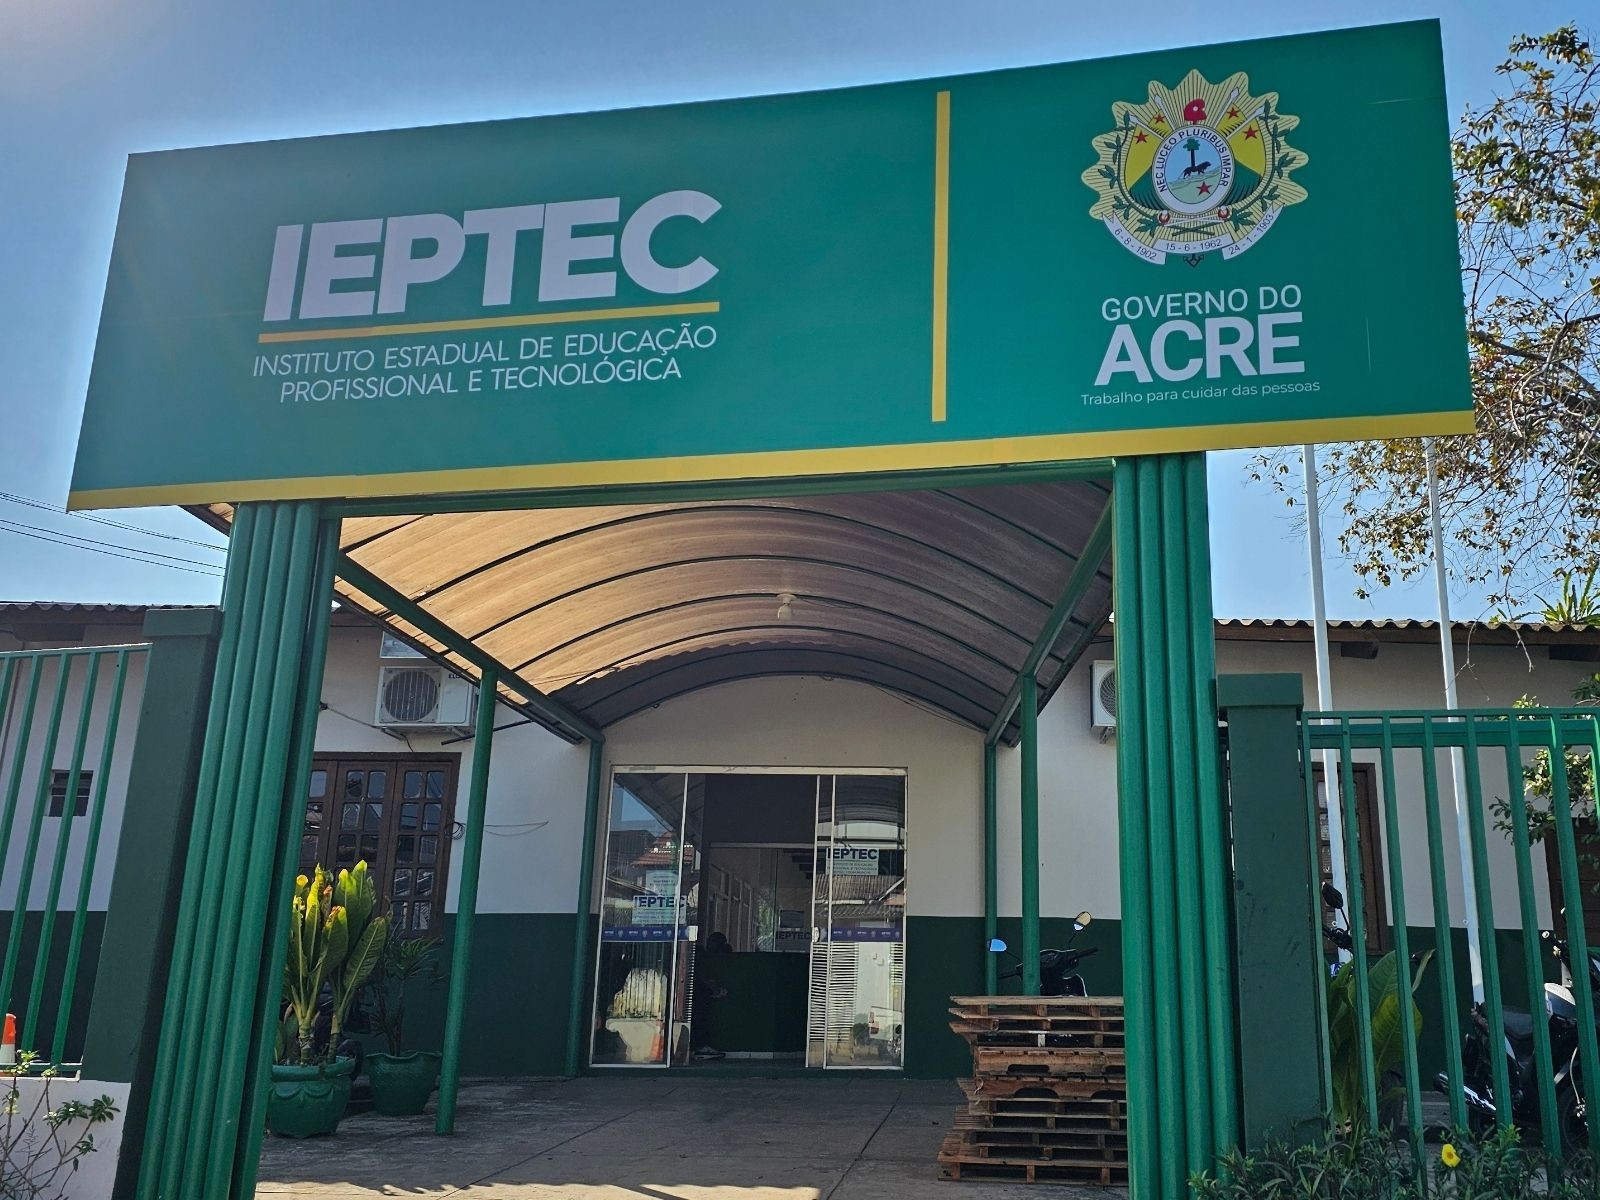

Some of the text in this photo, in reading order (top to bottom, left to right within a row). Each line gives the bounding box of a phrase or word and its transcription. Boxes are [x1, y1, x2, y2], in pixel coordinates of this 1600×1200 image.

[1155, 128, 1232, 193] NEC LUCEO PLURIBUS IMPAR
[263, 189, 723, 322] IEPTEC
[1101, 284, 1302, 321] GOVERNO DO
[253, 322, 717, 377] INSTITUTO ESTADUAL DE EDUCAÇÃO
[1094, 311, 1305, 386] ACRE
[280, 356, 682, 403] PROFISSIONAL E TECNOLÓGICA
[1081, 380, 1321, 405] Trabalho para cuidar das pessoas
[827, 848, 878, 860] IEPTEC
